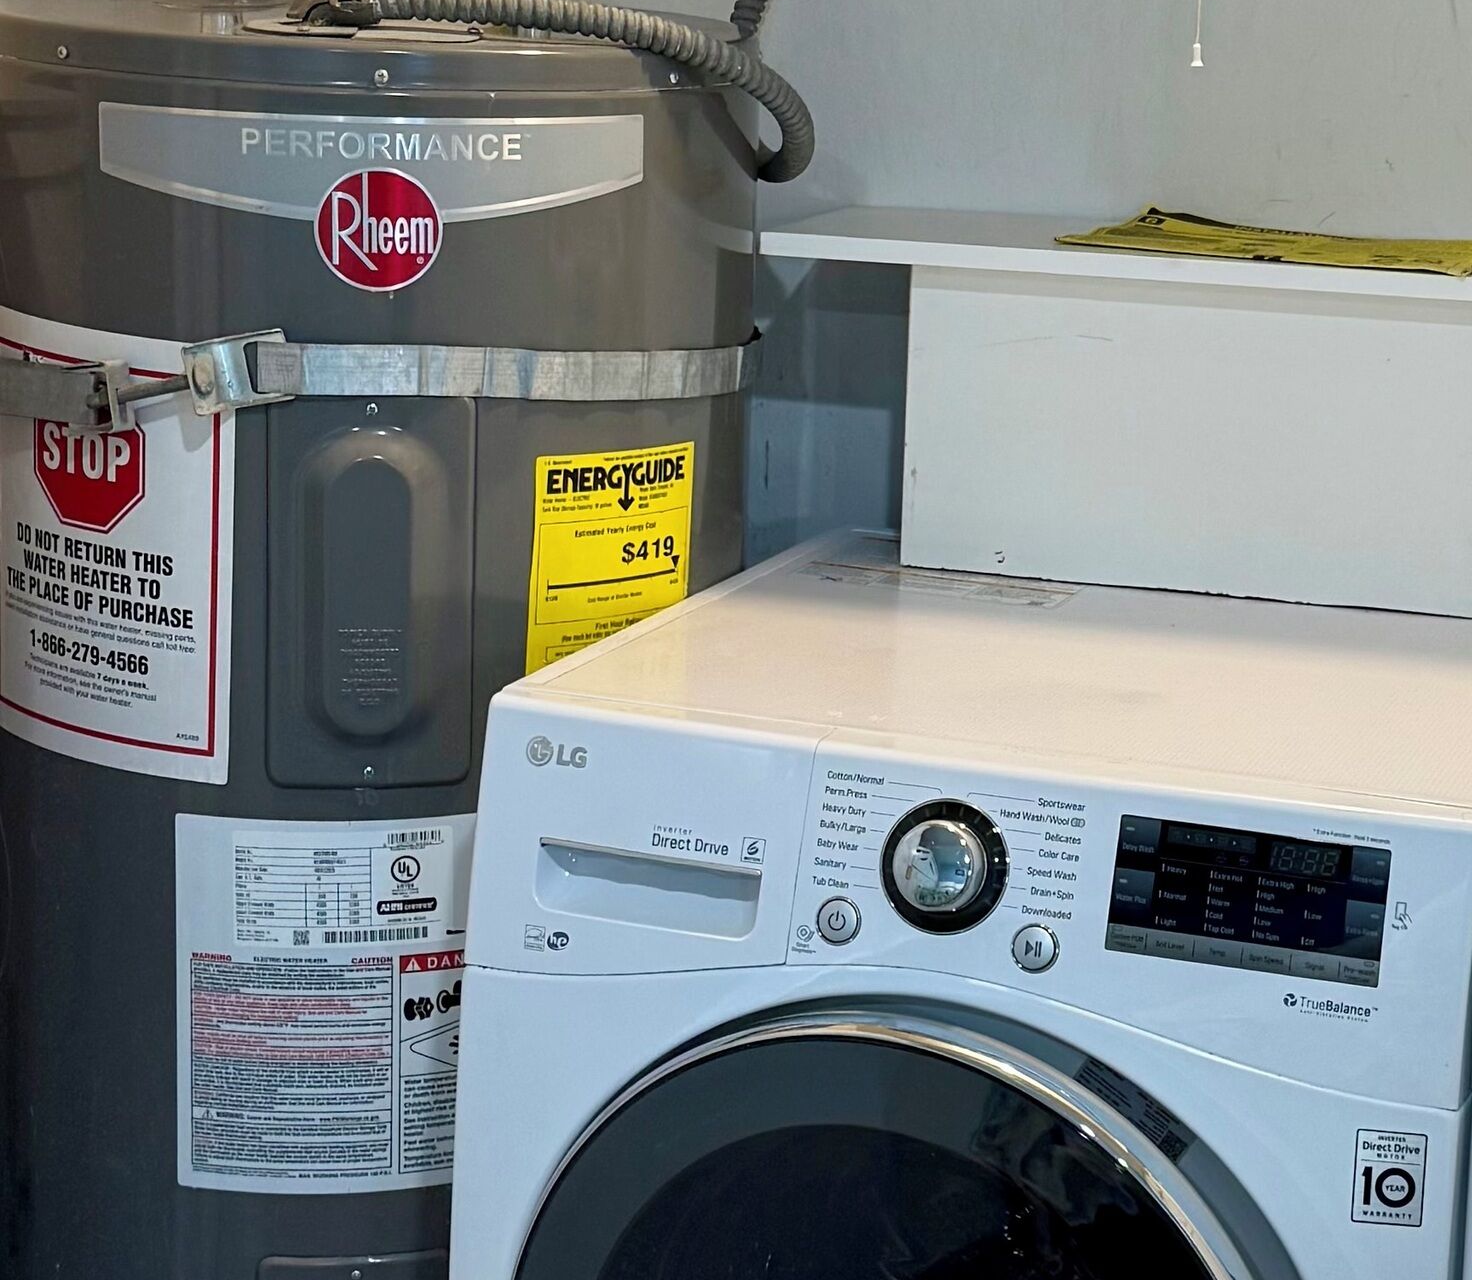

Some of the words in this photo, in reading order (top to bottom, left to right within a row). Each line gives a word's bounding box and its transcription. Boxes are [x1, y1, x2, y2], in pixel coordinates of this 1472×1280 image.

[241, 128, 522, 161] PERFORMANCE
[332, 172, 434, 271] Rheem
[43, 423, 130, 482] STOP
[546, 456, 685, 498] ENERGYGUIDE
[575, 528, 605, 538] Estimated
[607, 525, 624, 536] Yearly
[626, 524, 644, 534] Energy
[18, 522, 31, 544] DO
[35, 529, 60, 553] NOT
[65, 537, 126, 569] RETURN
[132, 551, 173, 576] THIS
[622, 536, 674, 565] $419
[24, 549, 66, 580] WATER
[71, 564, 132, 595] HEATER
[138, 578, 161, 600] TO
[7, 566, 26, 591] THE
[30, 579, 69, 606] PLACE
[74, 590, 93, 611] OF
[99, 596, 193, 629] PURCHASE
[100, 622, 117, 630] water
[145, 630, 173, 641] missing
[91, 630, 115, 640] general
[152, 640, 164, 649] call
[166, 642, 177, 651] toll
[30, 628, 149, 675] 1-866-279-4566
[98, 672, 102, 680] 7
[103, 675, 119, 686] days
[556, 744, 588, 768] LG
[827, 770, 885, 786] Cotton/Normal
[822, 803, 847, 815] Heavy
[848, 806, 866, 818] Duty
[1038, 798, 1086, 812] Sportswear
[1000, 809, 1021, 820] Hand
[1022, 812, 1070, 826] Wash/Wool
[654, 824, 692, 836] inverter
[820, 820, 866, 835] Bulky/Large
[652, 833, 691, 852] Direct
[694, 838, 729, 857] Drive
[817, 838, 837, 851] Baby
[838, 842, 859, 852] Wear
[1044, 832, 1081, 845] Delicates
[1038, 848, 1059, 860] Color
[1061, 852, 1080, 863] Care
[398, 861, 414, 877] UL
[814, 856, 847, 871] Sanitary
[1027, 866, 1052, 879] Speed
[1054, 870, 1077, 881] Wash
[812, 876, 827, 887] Tub
[828, 878, 849, 889] Clean
[1311, 886, 1326, 894] High
[1210, 898, 1230, 907] Warm
[1260, 892, 1275, 901] High
[1022, 905, 1072, 920] Downloaded
[1208, 912, 1223, 920] Cold
[1259, 905, 1284, 915] Medium
[1308, 912, 1322, 920] Low
[1208, 925, 1220, 935] Tap
[1258, 918, 1271, 927] Low
[192, 952, 232, 963] WARNING
[254, 956, 281, 964] ELECTRIC
[352, 956, 393, 965] CAUTION
[428, 953, 465, 969] DAN
[1300, 996, 1371, 1018] TrueBalance
[1378, 1135, 1406, 1143] INVERTER
[1362, 1140, 1392, 1152] Direct
[1394, 1144, 1420, 1155] Drive
[1362, 1166, 1416, 1208] 10
[1385, 1185, 1405, 1193] YEAR
[1362, 1210, 1412, 1220] WARRANTY
